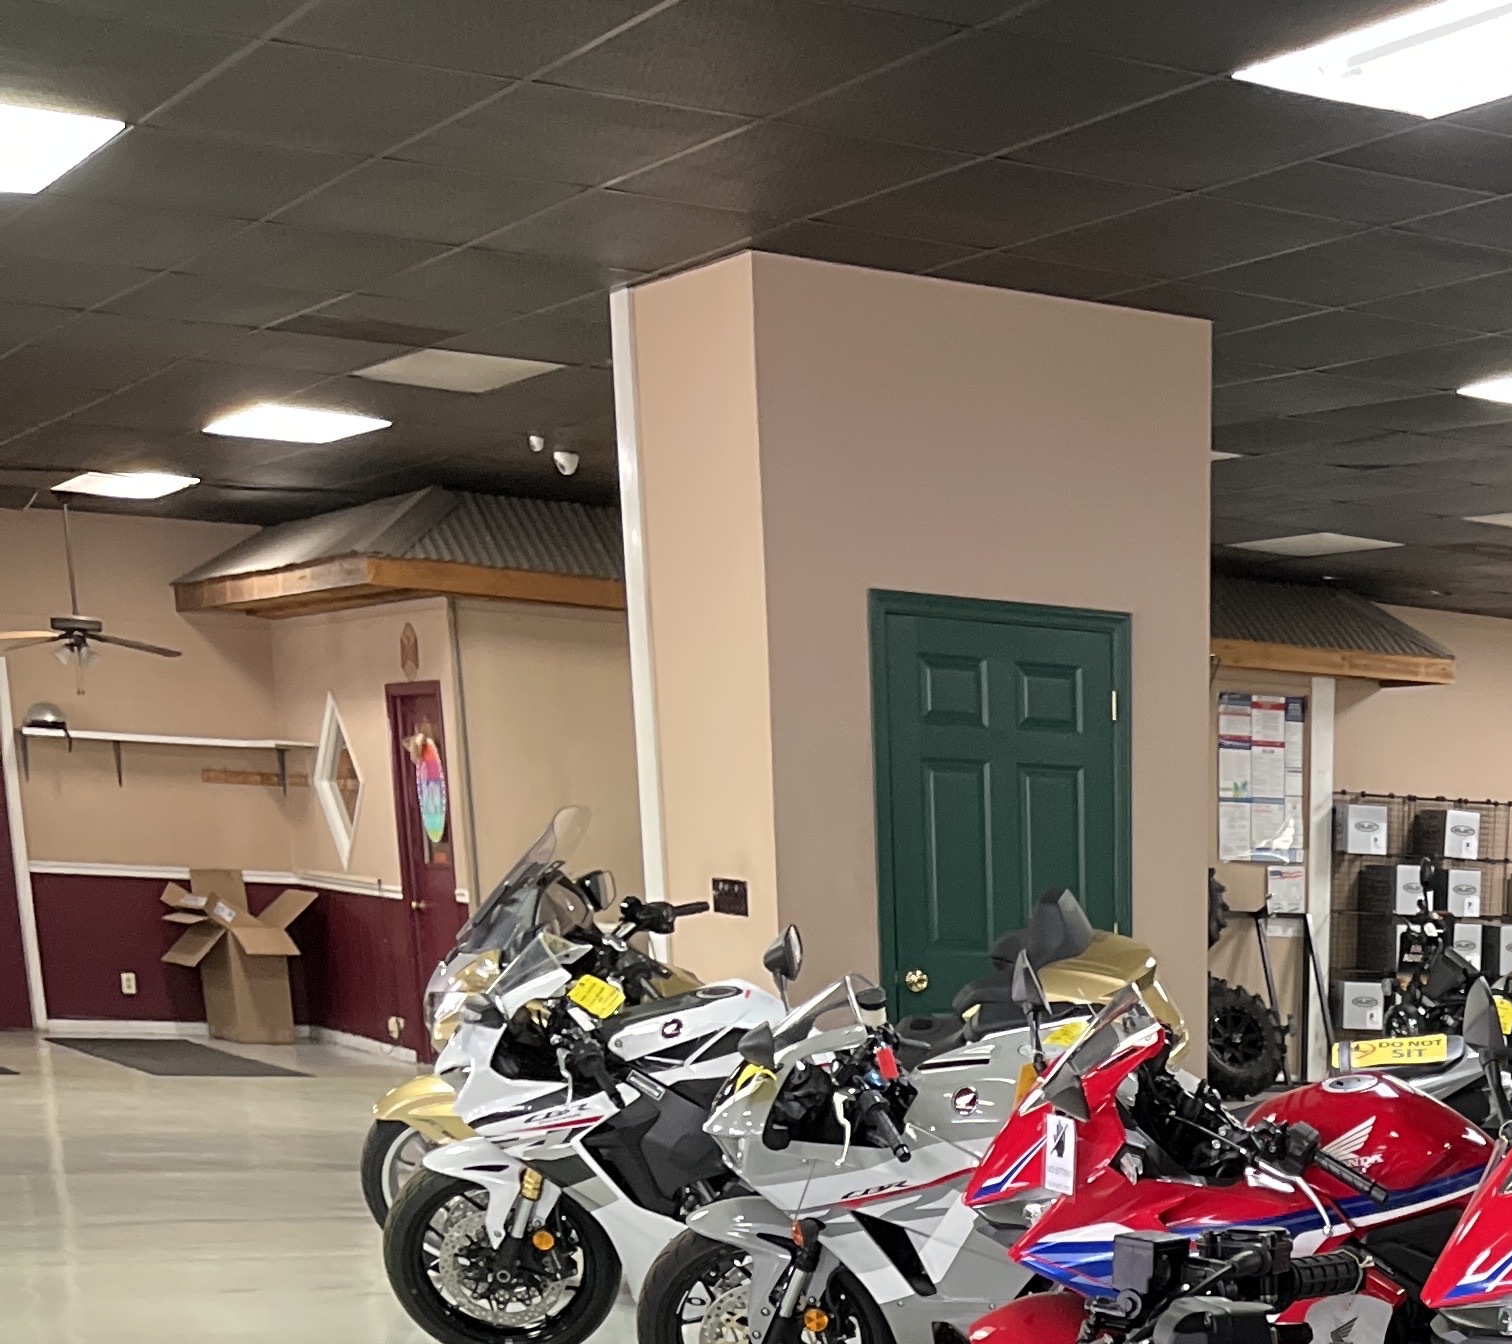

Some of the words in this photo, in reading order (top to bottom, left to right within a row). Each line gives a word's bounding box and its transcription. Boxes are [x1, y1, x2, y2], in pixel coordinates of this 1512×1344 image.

[1379, 1040, 1404, 1049] DO
[1408, 1038, 1443, 1048] NOT
[1391, 1047, 1427, 1059] SIT
